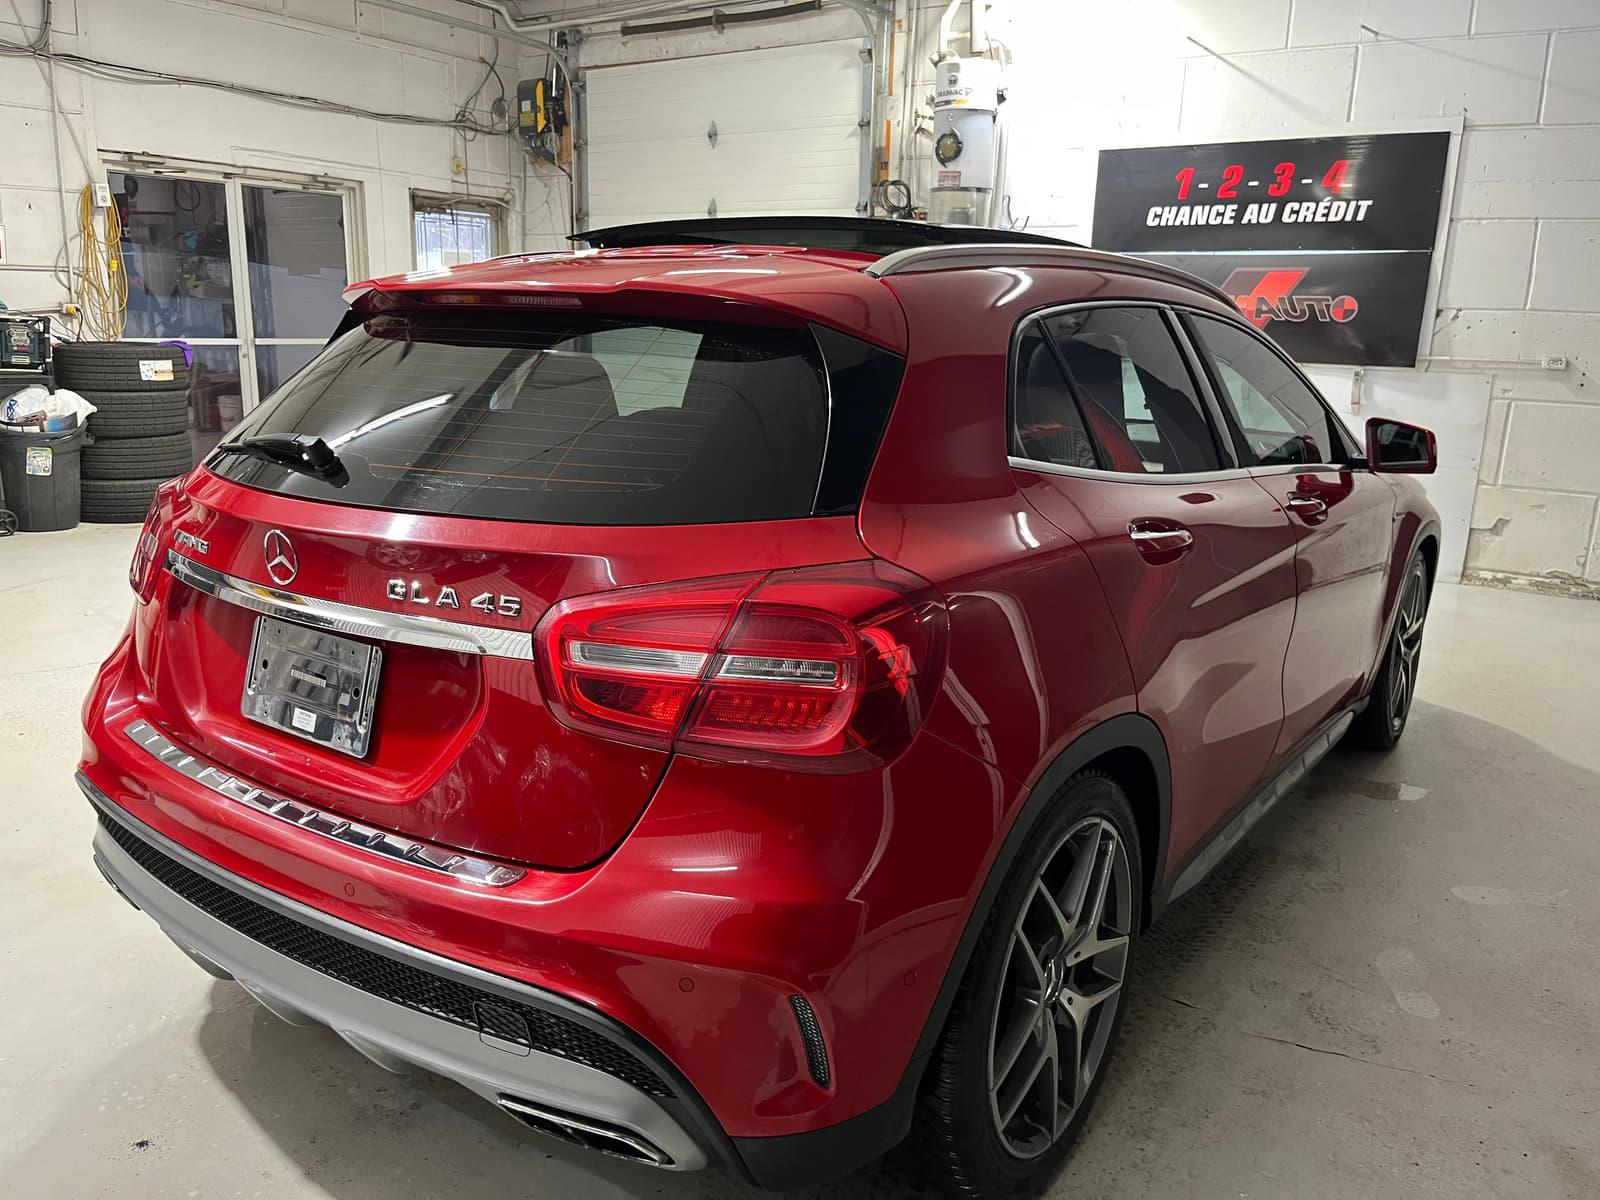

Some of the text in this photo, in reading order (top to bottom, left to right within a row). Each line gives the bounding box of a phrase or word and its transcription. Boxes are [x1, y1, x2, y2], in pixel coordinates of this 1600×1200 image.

[1146, 196, 1374, 227] CHANCE AU CRÉDIT
[386, 578, 522, 617] GLA 45
